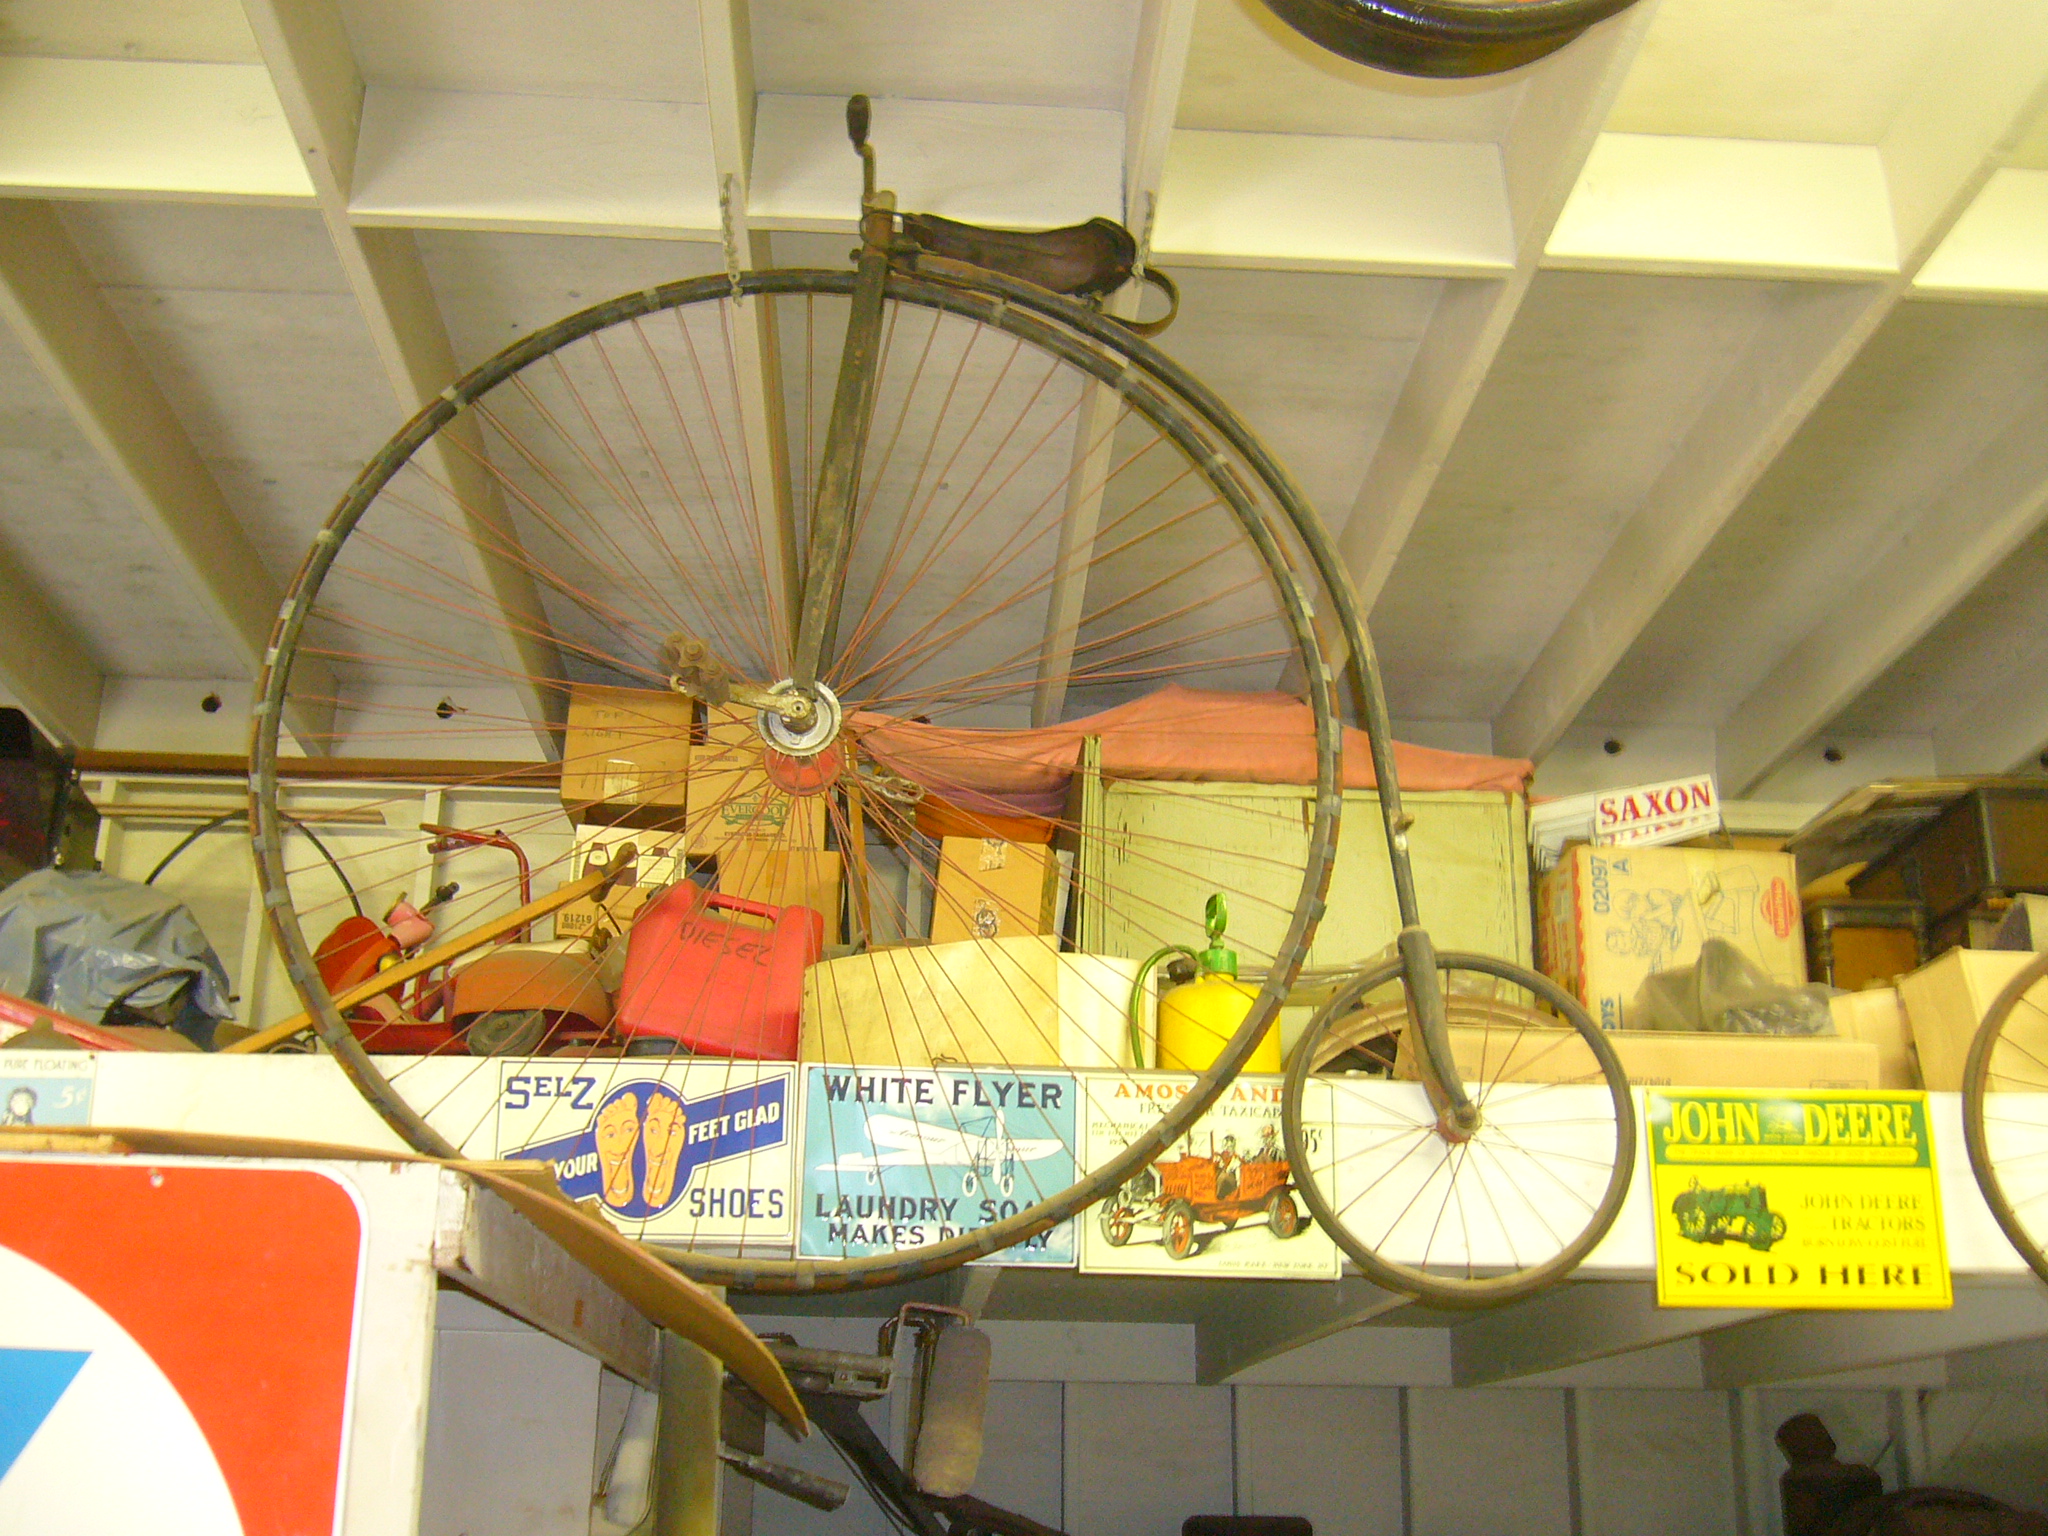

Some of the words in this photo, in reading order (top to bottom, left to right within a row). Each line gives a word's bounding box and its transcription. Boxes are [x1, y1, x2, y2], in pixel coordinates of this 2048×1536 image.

[1599, 780, 1712, 827] SAXON
[1612, 858, 1630, 874] A
[1590, 855, 1611, 914] 02097
[505, 1076, 597, 1110] SELZ
[824, 1074, 934, 1104] WHITE
[952, 1079, 1063, 1109] FLYER
[1114, 1083, 1189, 1099] AMOS
[688, 1115, 731, 1145] FEET
[734, 1102, 780, 1132] GLAD
[1663, 1101, 1760, 1144] JOHN
[1802, 1103, 1918, 1146] DEERE
[555, 1152, 598, 1180] YOUR
[690, 1189, 784, 1219] SHOES
[815, 1193, 959, 1221] LAUNDRY
[979, 1199, 1034, 1222] SO
[1800, 1193, 1853, 1209] JOHN
[1860, 1193, 1923, 1210] DEERE
[828, 1223, 925, 1245] MAKES
[1832, 1216, 1926, 1231] TRACTORS
[1675, 1262, 1799, 1288] SOLD
[1818, 1263, 1933, 1289] HERE
